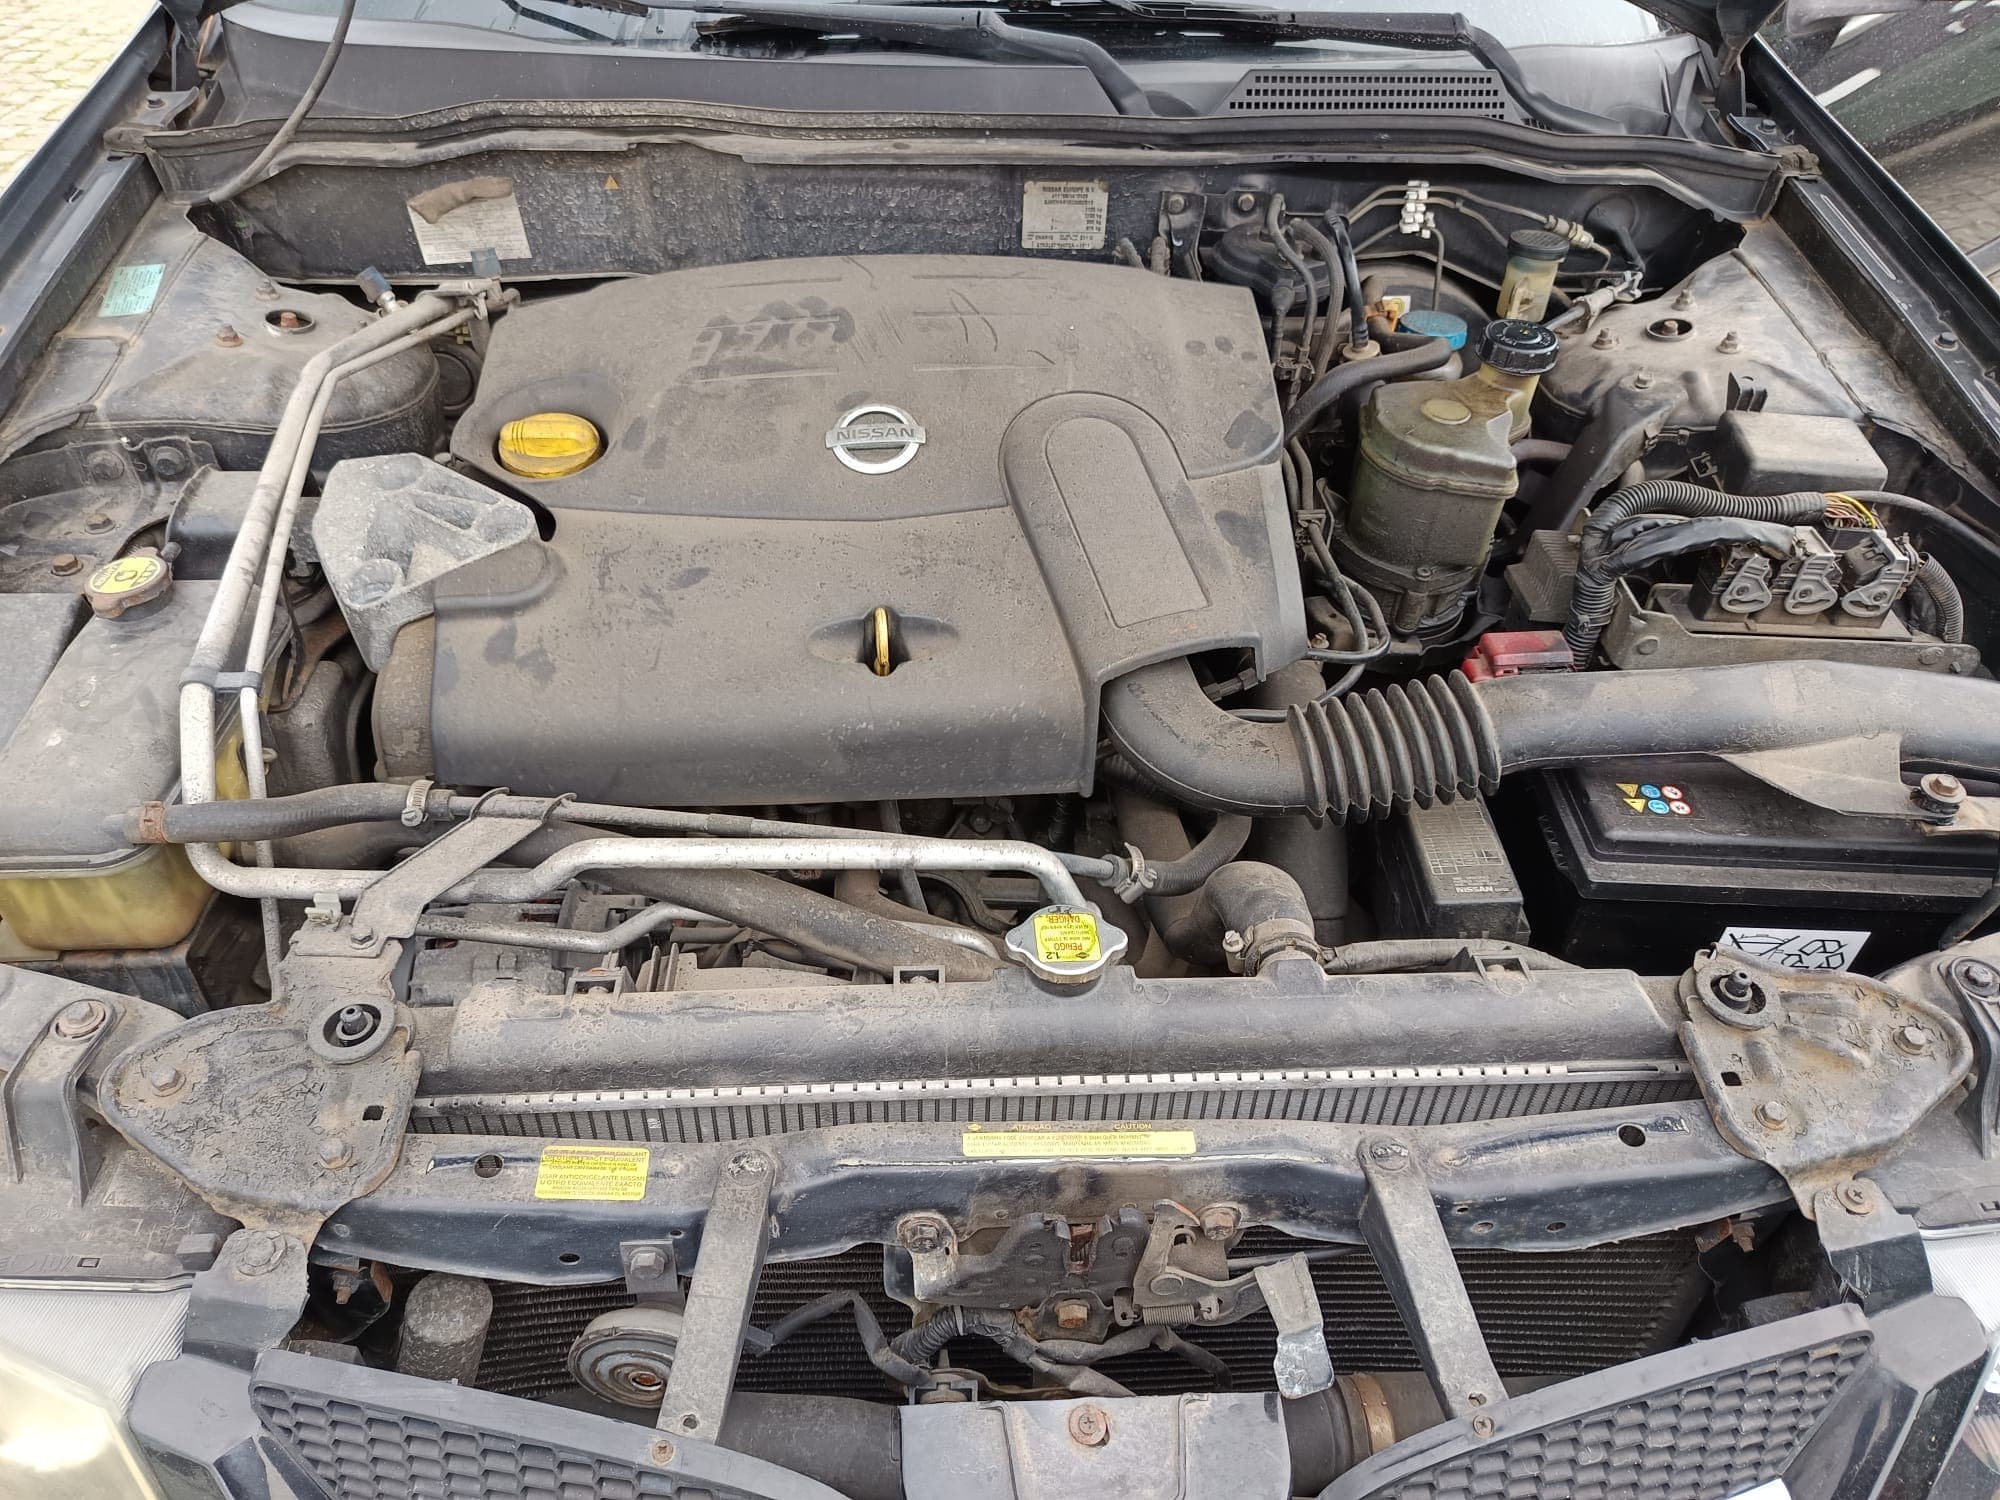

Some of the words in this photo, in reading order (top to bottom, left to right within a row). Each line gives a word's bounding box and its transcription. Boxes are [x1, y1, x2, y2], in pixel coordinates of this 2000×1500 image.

[836, 427, 914, 440] NISSAN
[1048, 915, 1080, 923] DANGER
[1054, 943, 1083, 951] PERIGO
[1046, 952, 1060, 960] 1.2
[1114, 1122, 1152, 1130] CAUTION
